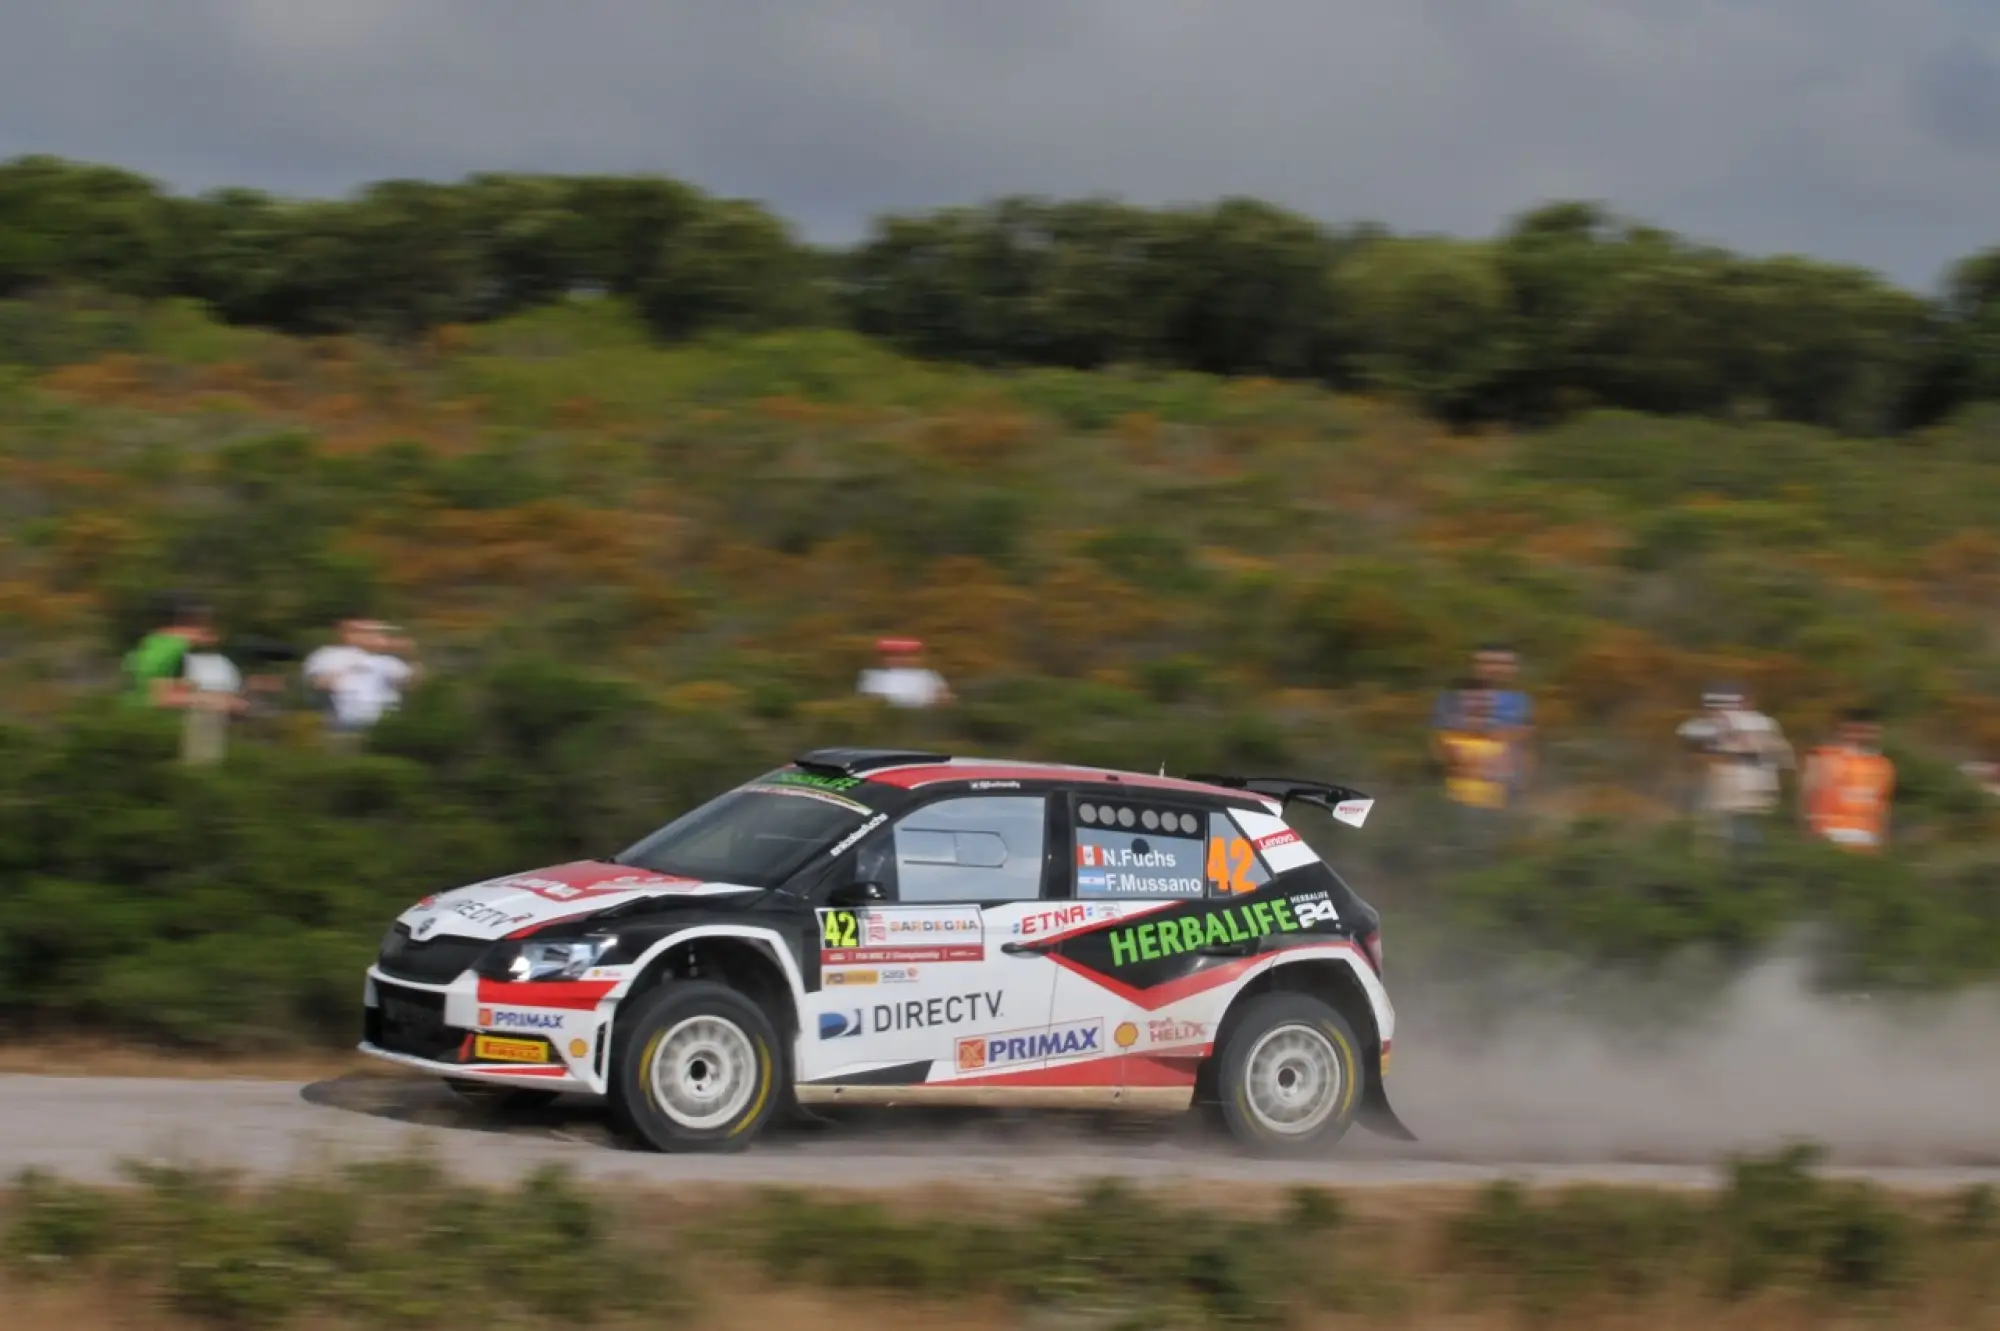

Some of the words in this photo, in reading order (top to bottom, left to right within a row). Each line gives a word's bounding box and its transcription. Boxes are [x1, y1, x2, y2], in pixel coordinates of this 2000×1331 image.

[1259, 834, 1295, 849] Lenovo
[1103, 848, 1176, 868] N.Fuchs
[1207, 836, 1257, 893] 42
[1105, 874, 1201, 893] F.Mussano
[1290, 890, 1329, 903] HERBALIFE
[890, 919, 979, 932] SARDEGNA
[1022, 905, 1086, 935] ETNA
[1294, 900, 1340, 929] 24
[824, 908, 858, 948] 42
[1108, 898, 1299, 967] HERBALIFE
[495, 1011, 564, 1029] PRIMAX
[874, 990, 1003, 1033] DIRECTV
[988, 1026, 1099, 1063] PRIMAX
[1150, 1022, 1208, 1043] HELIX
